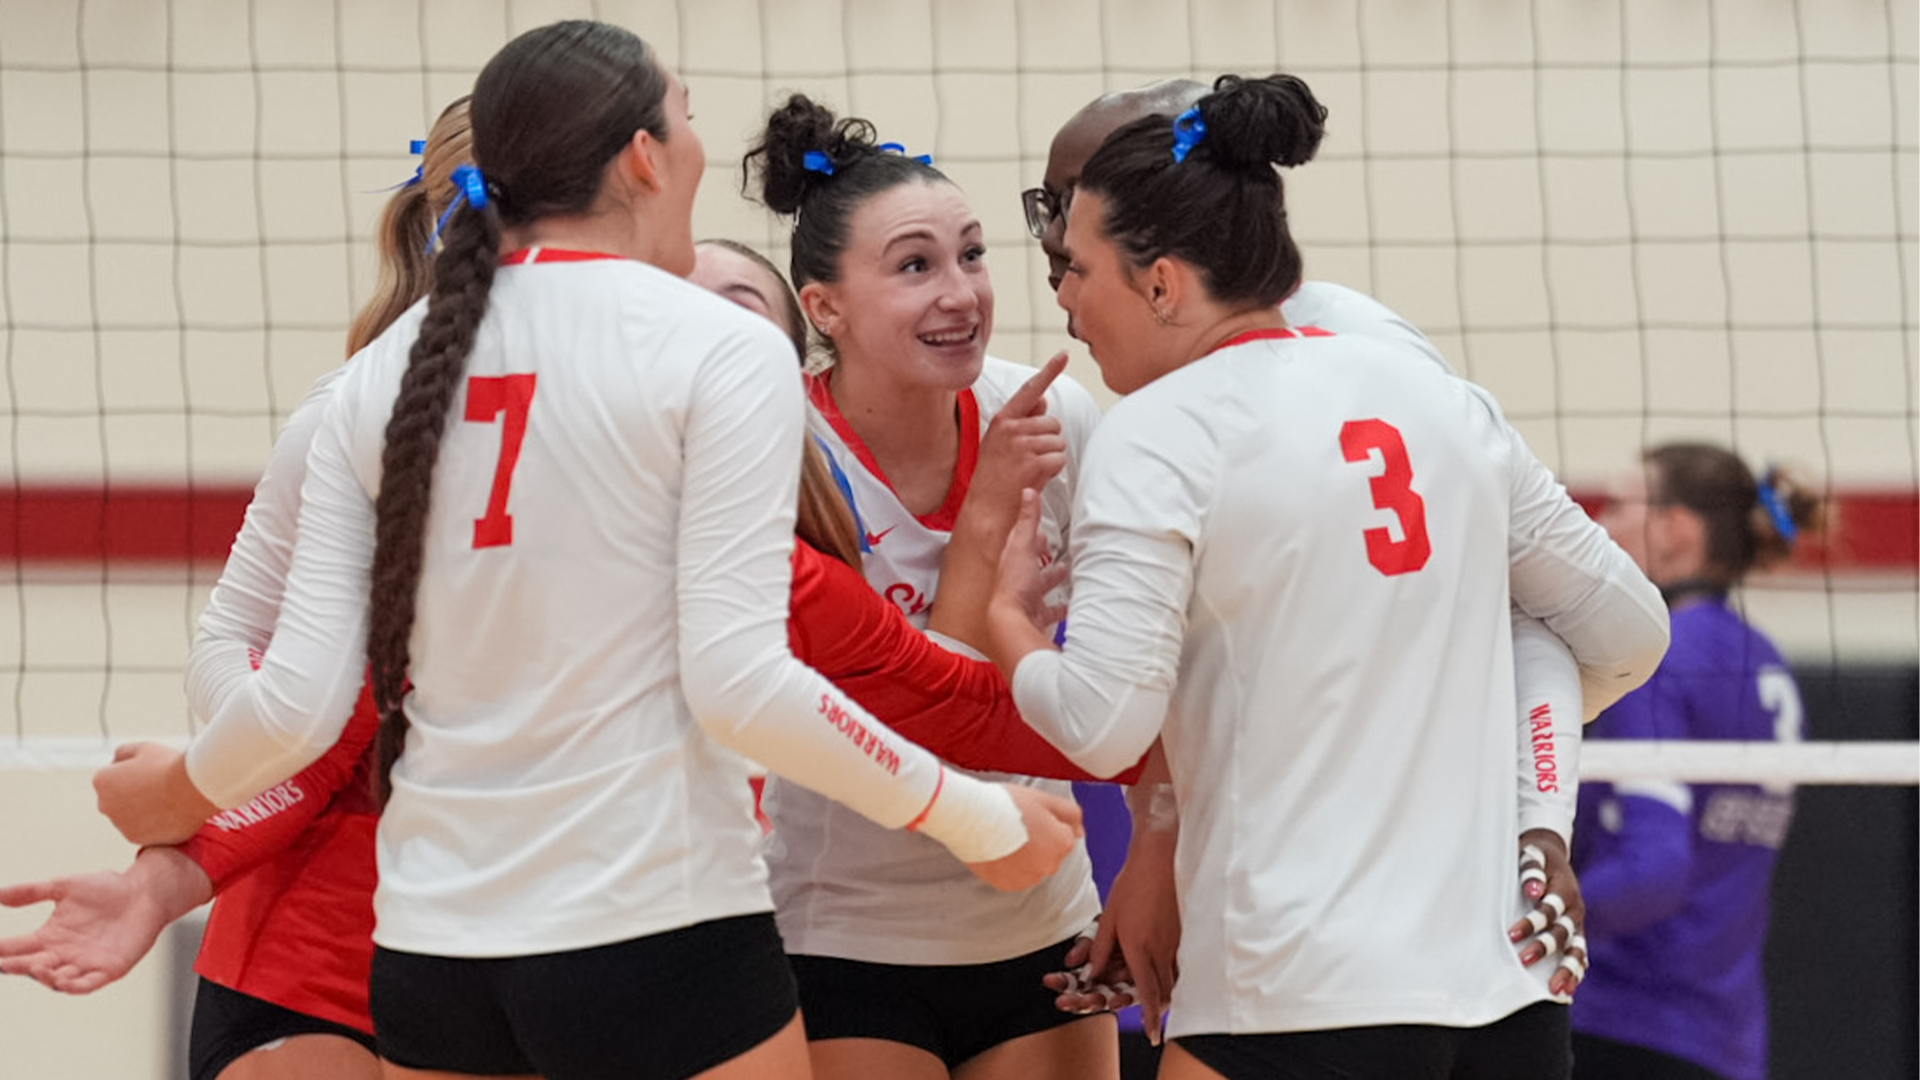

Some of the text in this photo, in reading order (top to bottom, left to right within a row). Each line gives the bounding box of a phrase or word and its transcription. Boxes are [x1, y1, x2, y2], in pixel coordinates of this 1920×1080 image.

[464, 373, 537, 549] 7
[1338, 418, 1432, 577] 3
[818, 693, 901, 776] WARRIORS
[1529, 702, 1558, 794] WARRIORS
[206, 779, 304, 832] WARRIORS
